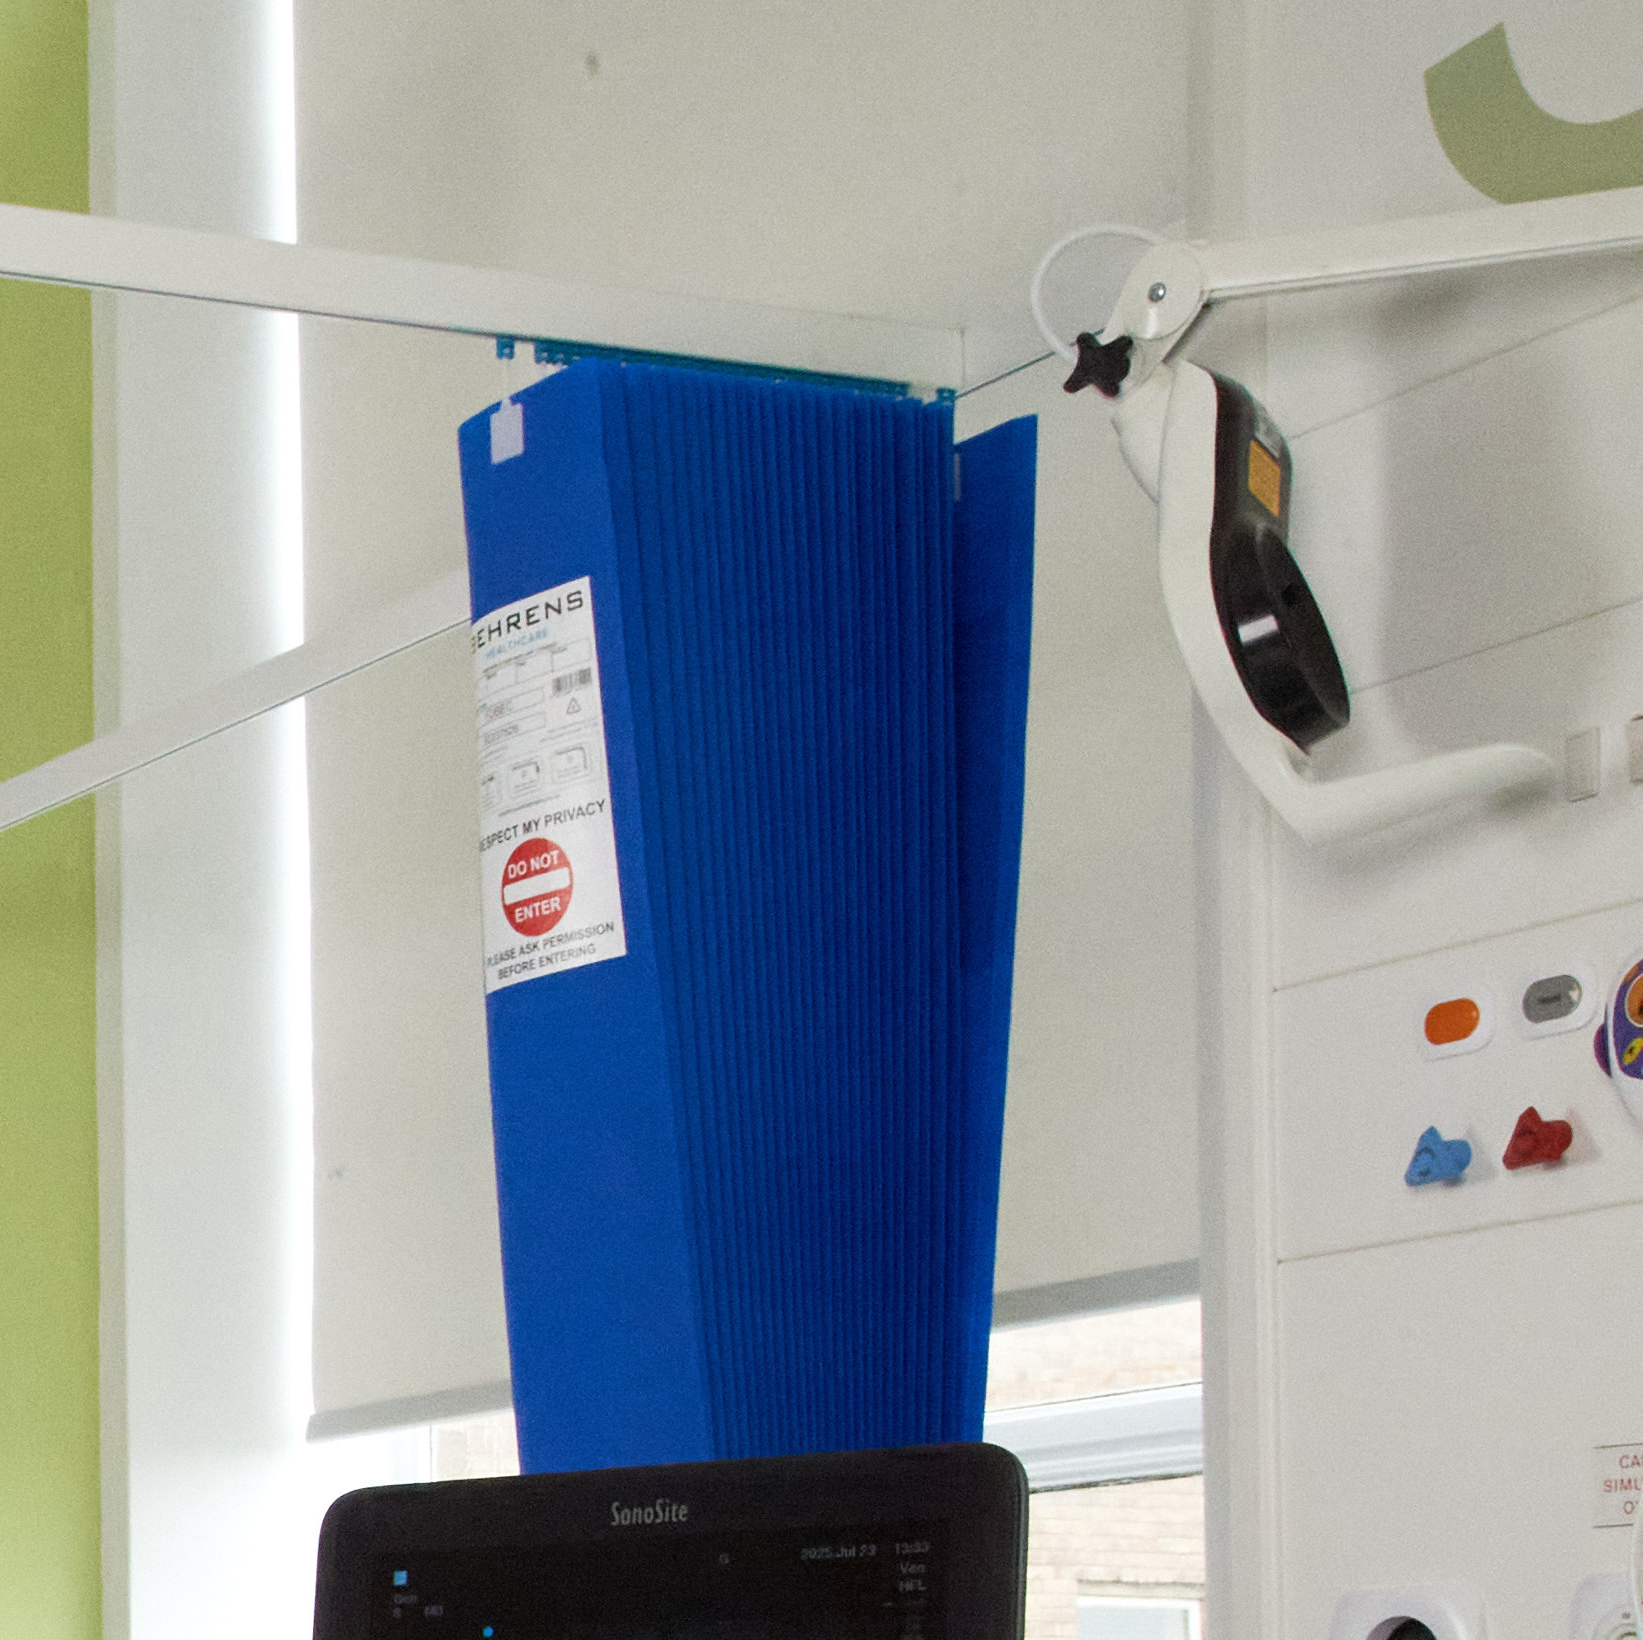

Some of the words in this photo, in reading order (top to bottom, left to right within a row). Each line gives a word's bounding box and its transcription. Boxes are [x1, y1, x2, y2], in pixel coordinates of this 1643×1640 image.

[522, 817, 541, 835] MY
[544, 799, 606, 828] PRIVACY
[507, 860, 528, 880] DO
[530, 850, 560, 872] NOT
[514, 896, 562, 923] ENTER
[518, 940, 541, 956] ASK
[542, 922, 615, 950] PERMISSION
[498, 958, 536, 980] BEFORE
[538, 943, 597, 968] ENTERING
[610, 1498, 689, 1526] SonoSite
